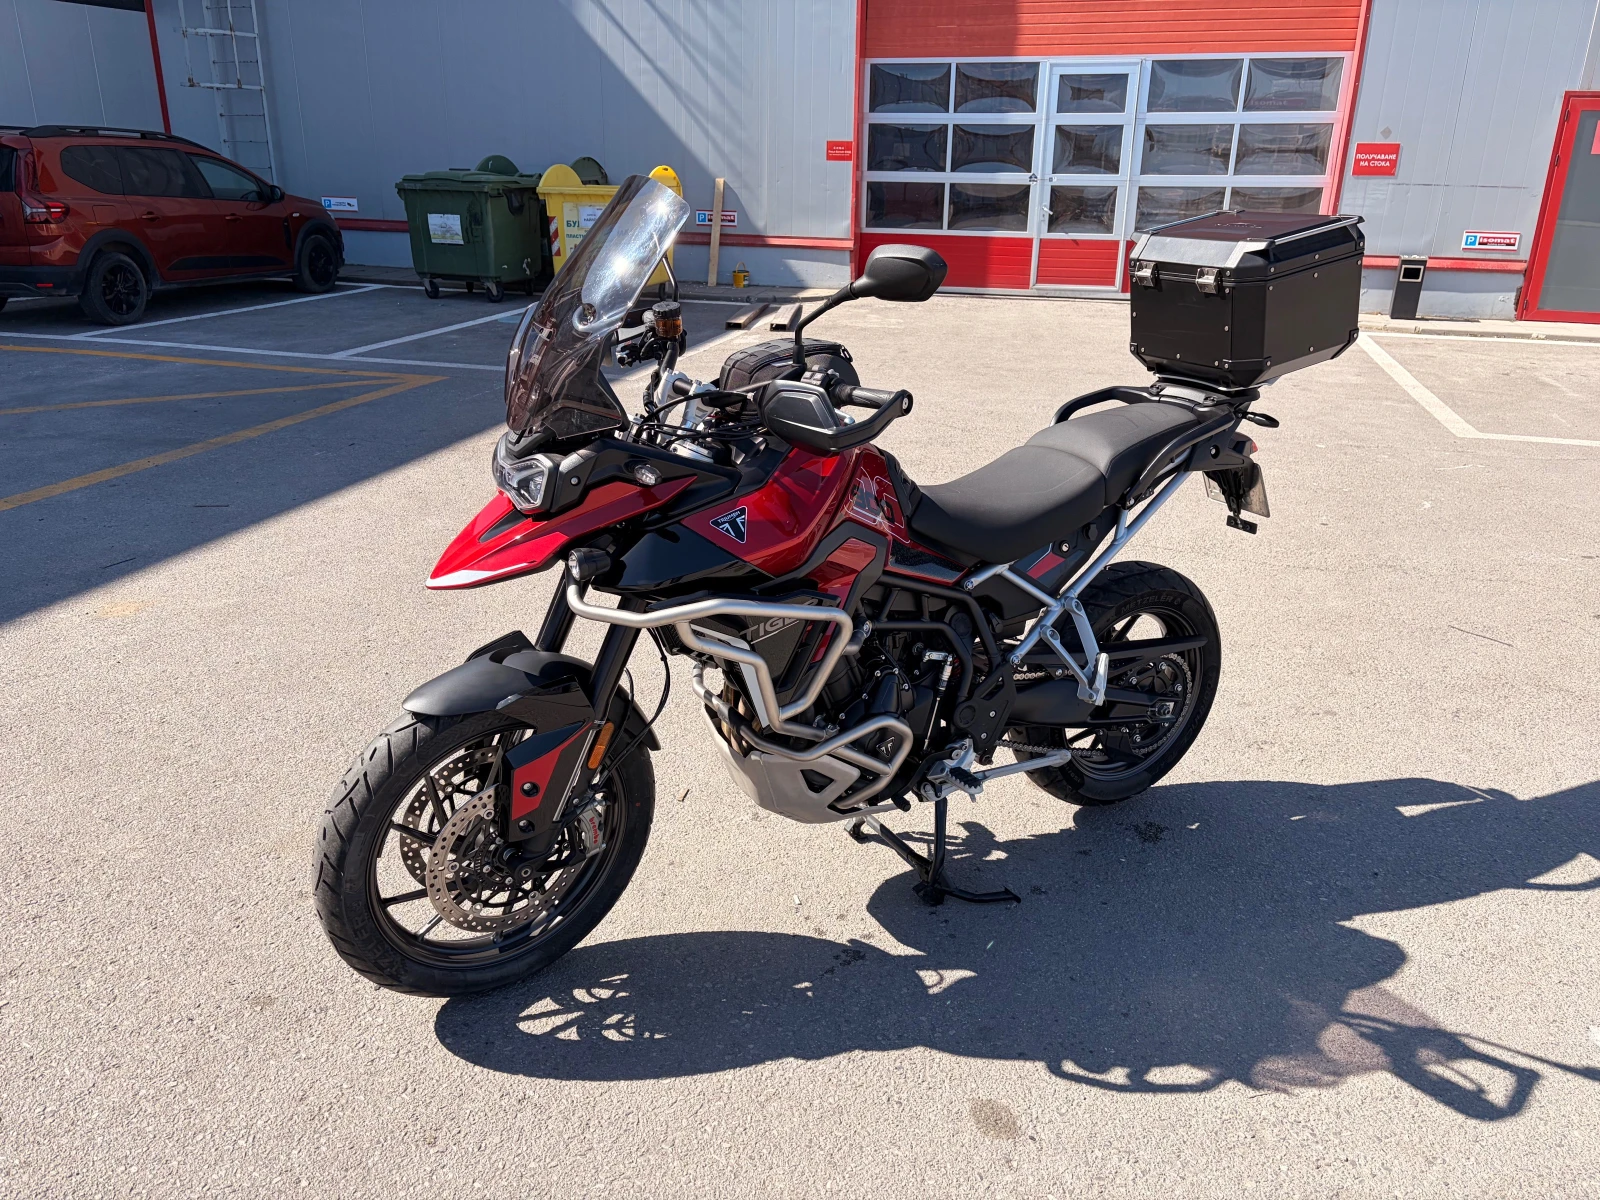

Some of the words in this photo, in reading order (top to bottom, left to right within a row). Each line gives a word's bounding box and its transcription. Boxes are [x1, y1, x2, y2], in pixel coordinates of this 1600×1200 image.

[1479, 236, 1516, 244] isomat
[717, 510, 741, 523] TRIUMPH
[1121, 595, 1174, 614] METZELER
[589, 816, 600, 844] brembo
